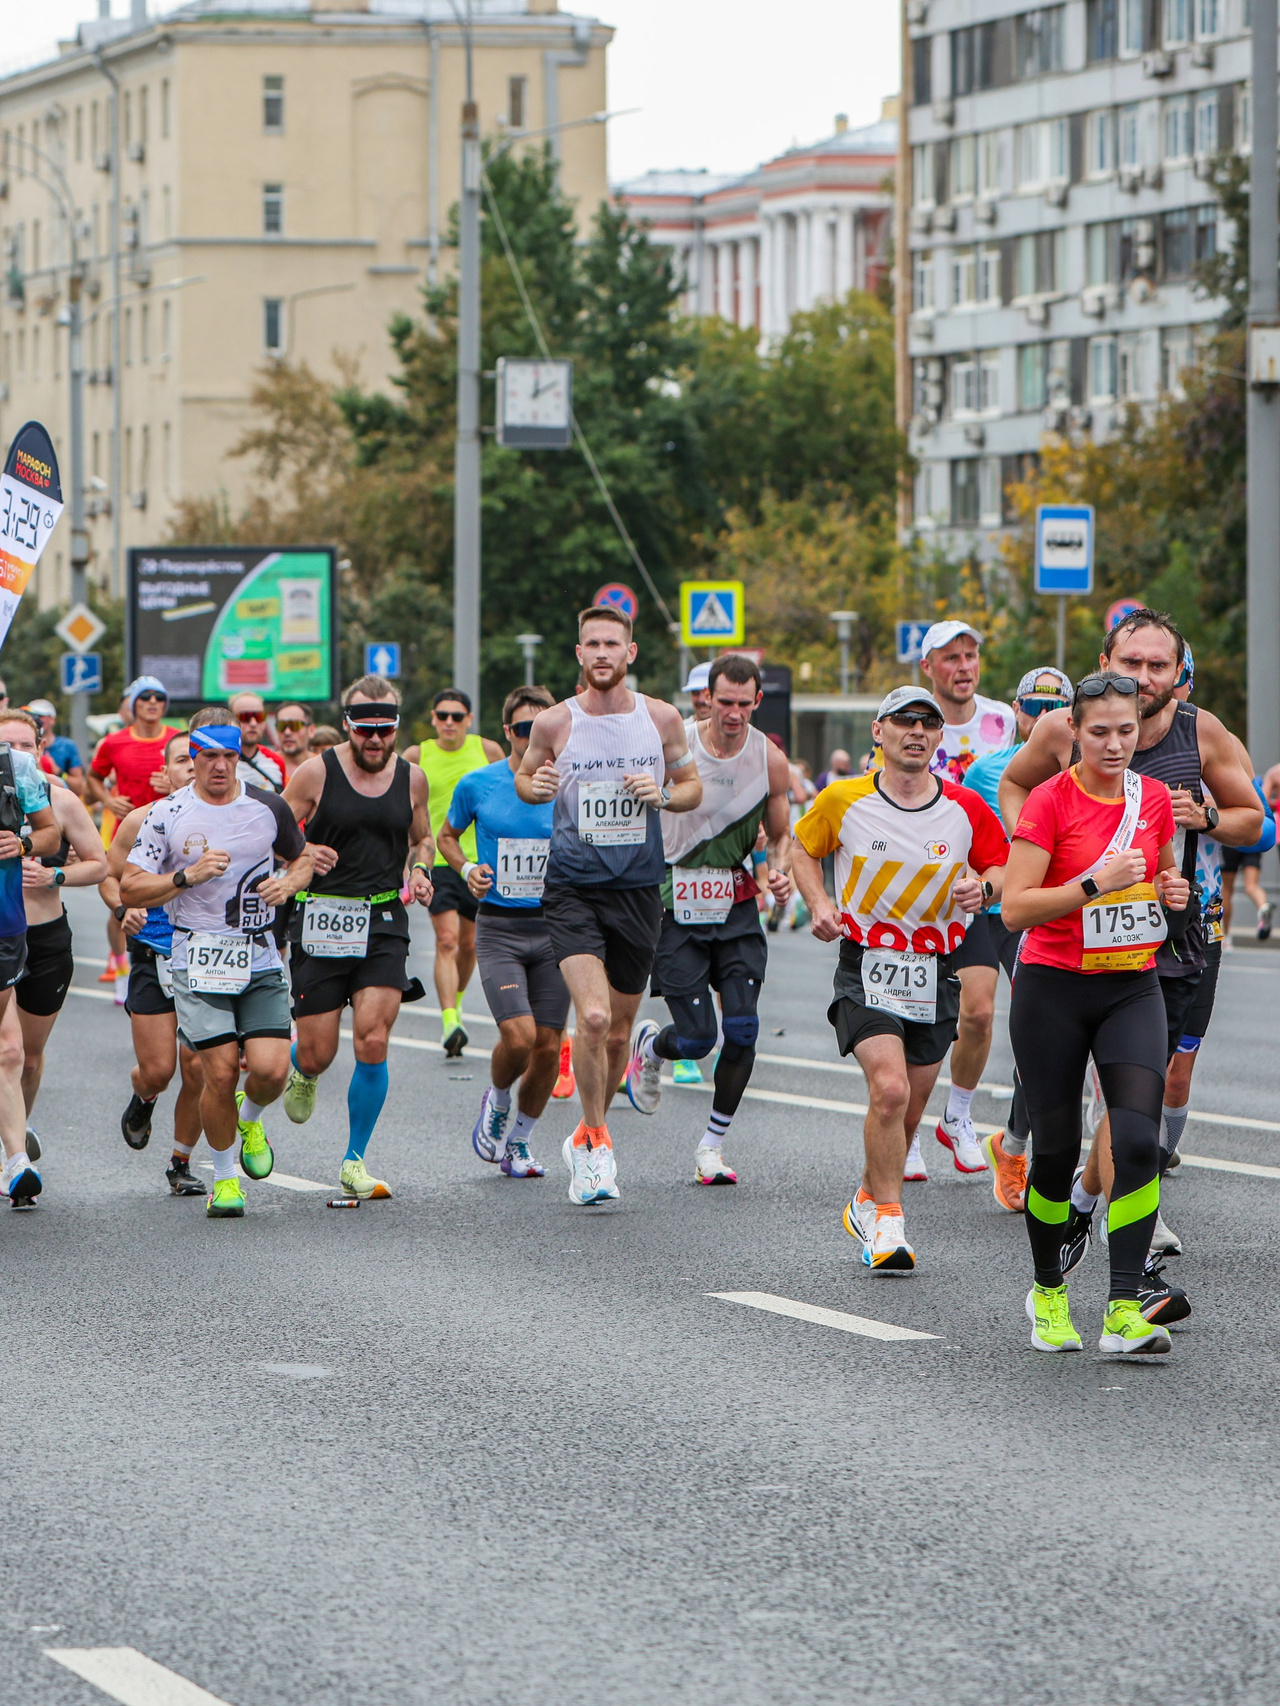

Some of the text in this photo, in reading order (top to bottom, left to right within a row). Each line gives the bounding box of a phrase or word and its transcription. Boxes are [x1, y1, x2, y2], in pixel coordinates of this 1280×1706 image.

[16, 449, 51, 479] МАРАФОН
[14, 461, 44, 489] МОСКВА
[0, 487, 41, 550] 3:29
[606, 758, 625, 768] WE
[582, 798, 645, 818] 10107
[516, 874, 543, 882] ВАЛЕРИЙ
[502, 885, 511, 896] D
[676, 881, 733, 900] 21824
[683, 910, 691, 920] D
[1089, 902, 1162, 934] 175-5
[307, 912, 367, 933] 18689
[219, 939, 235, 947] 42,2
[307, 944, 315, 955] D
[187, 946, 249, 969] 15748
[899, 954, 917, 962] 42,2
[868, 962, 927, 988] 6713
[190, 978, 198, 989] D
[882, 988, 912, 997] АНДРЕЙ
[870, 994, 879, 1006] D
